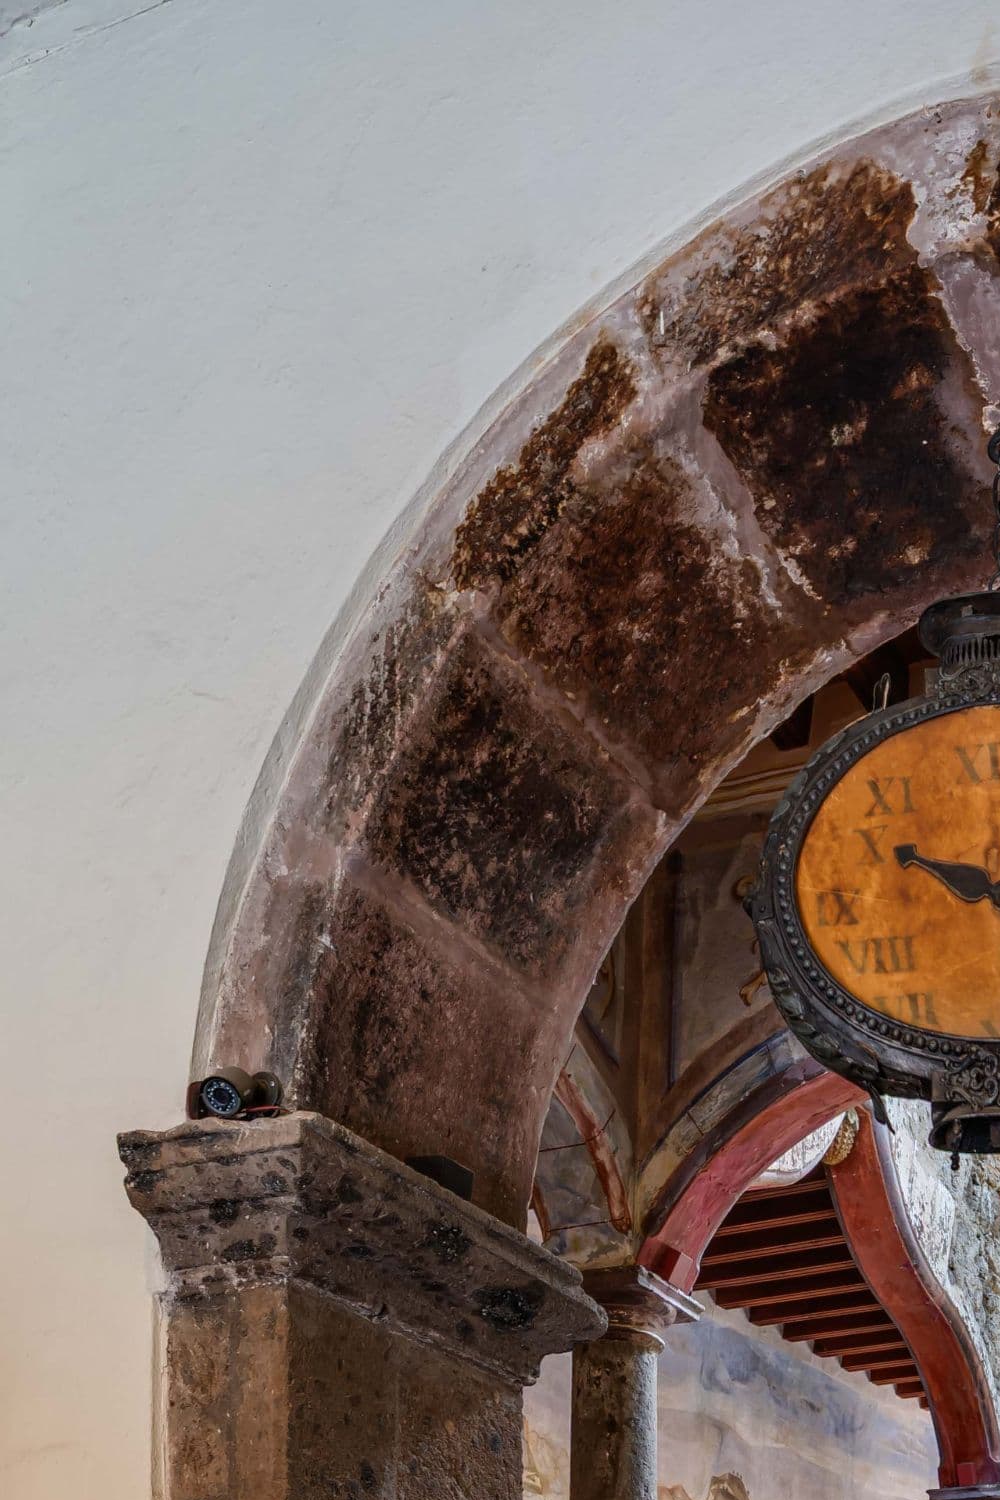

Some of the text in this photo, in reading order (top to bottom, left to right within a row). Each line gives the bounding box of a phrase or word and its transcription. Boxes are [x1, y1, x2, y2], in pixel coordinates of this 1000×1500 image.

[866, 776, 914, 816] XI
[853, 825, 887, 865] X
[817, 889, 862, 927] IX
[836, 935, 916, 975] VIII
